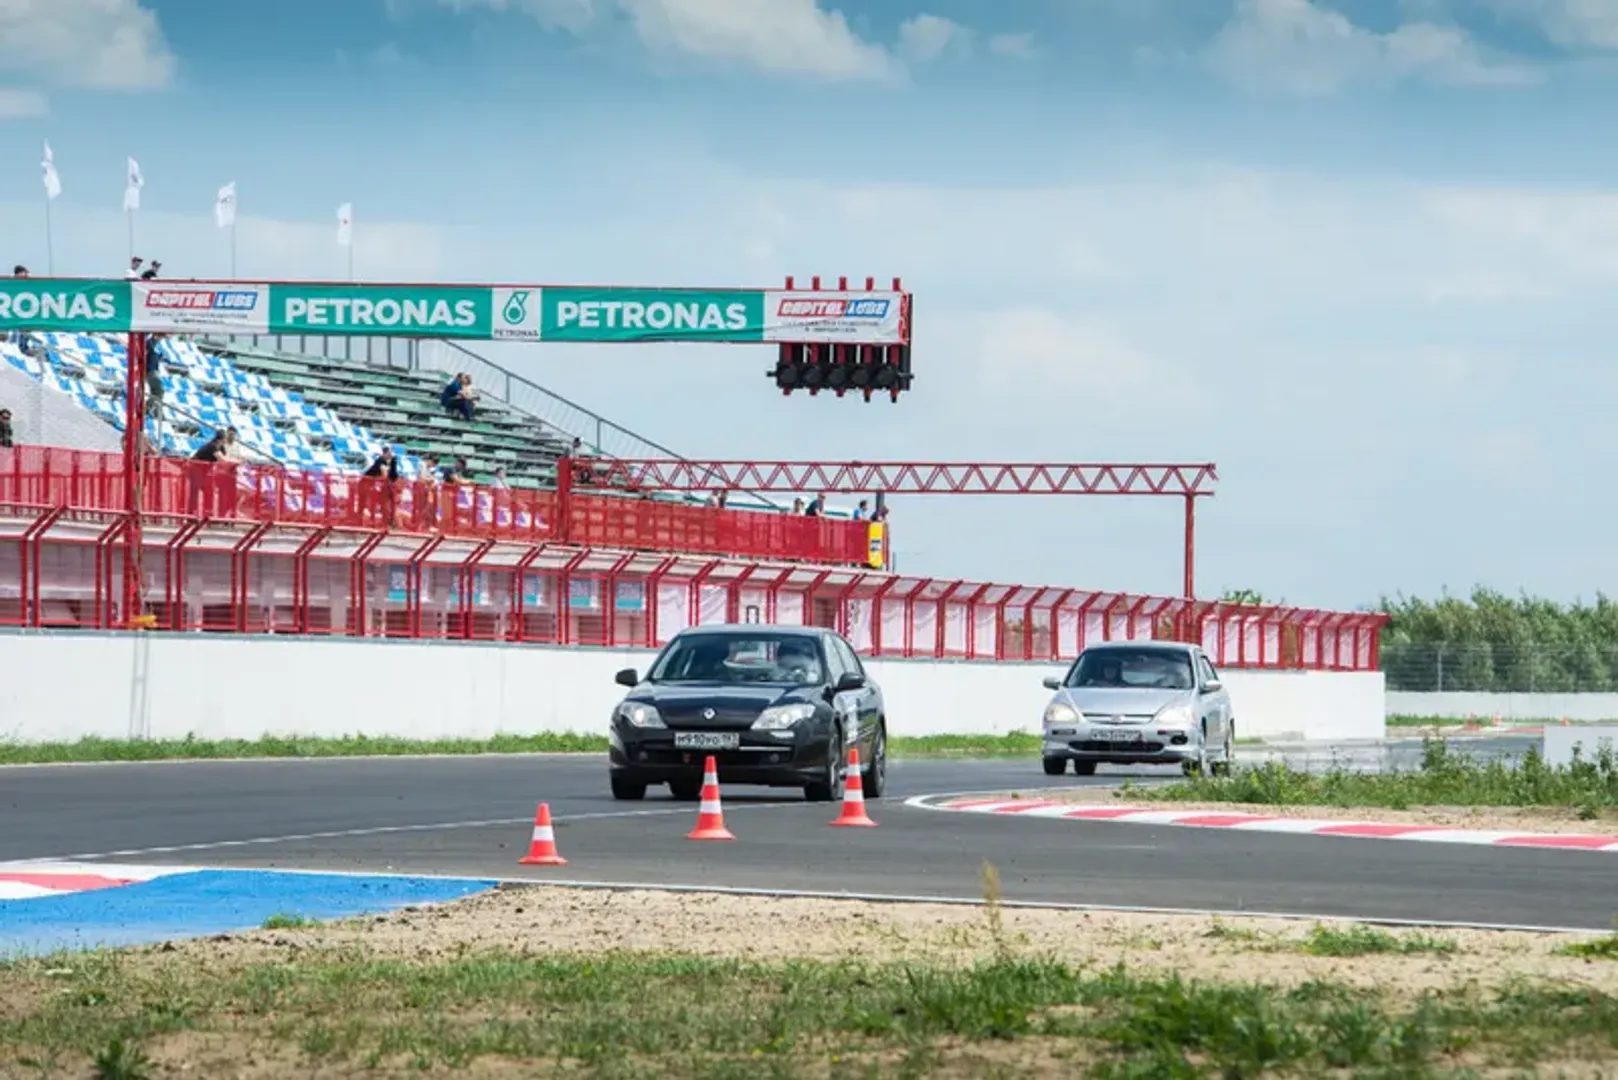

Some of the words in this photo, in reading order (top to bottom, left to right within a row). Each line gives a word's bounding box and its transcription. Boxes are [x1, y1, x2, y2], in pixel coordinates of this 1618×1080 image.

[285, 298, 476, 326] PETRONAS
[557, 301, 747, 329] PETRONAS
[494, 329, 539, 337] PETRONAS
